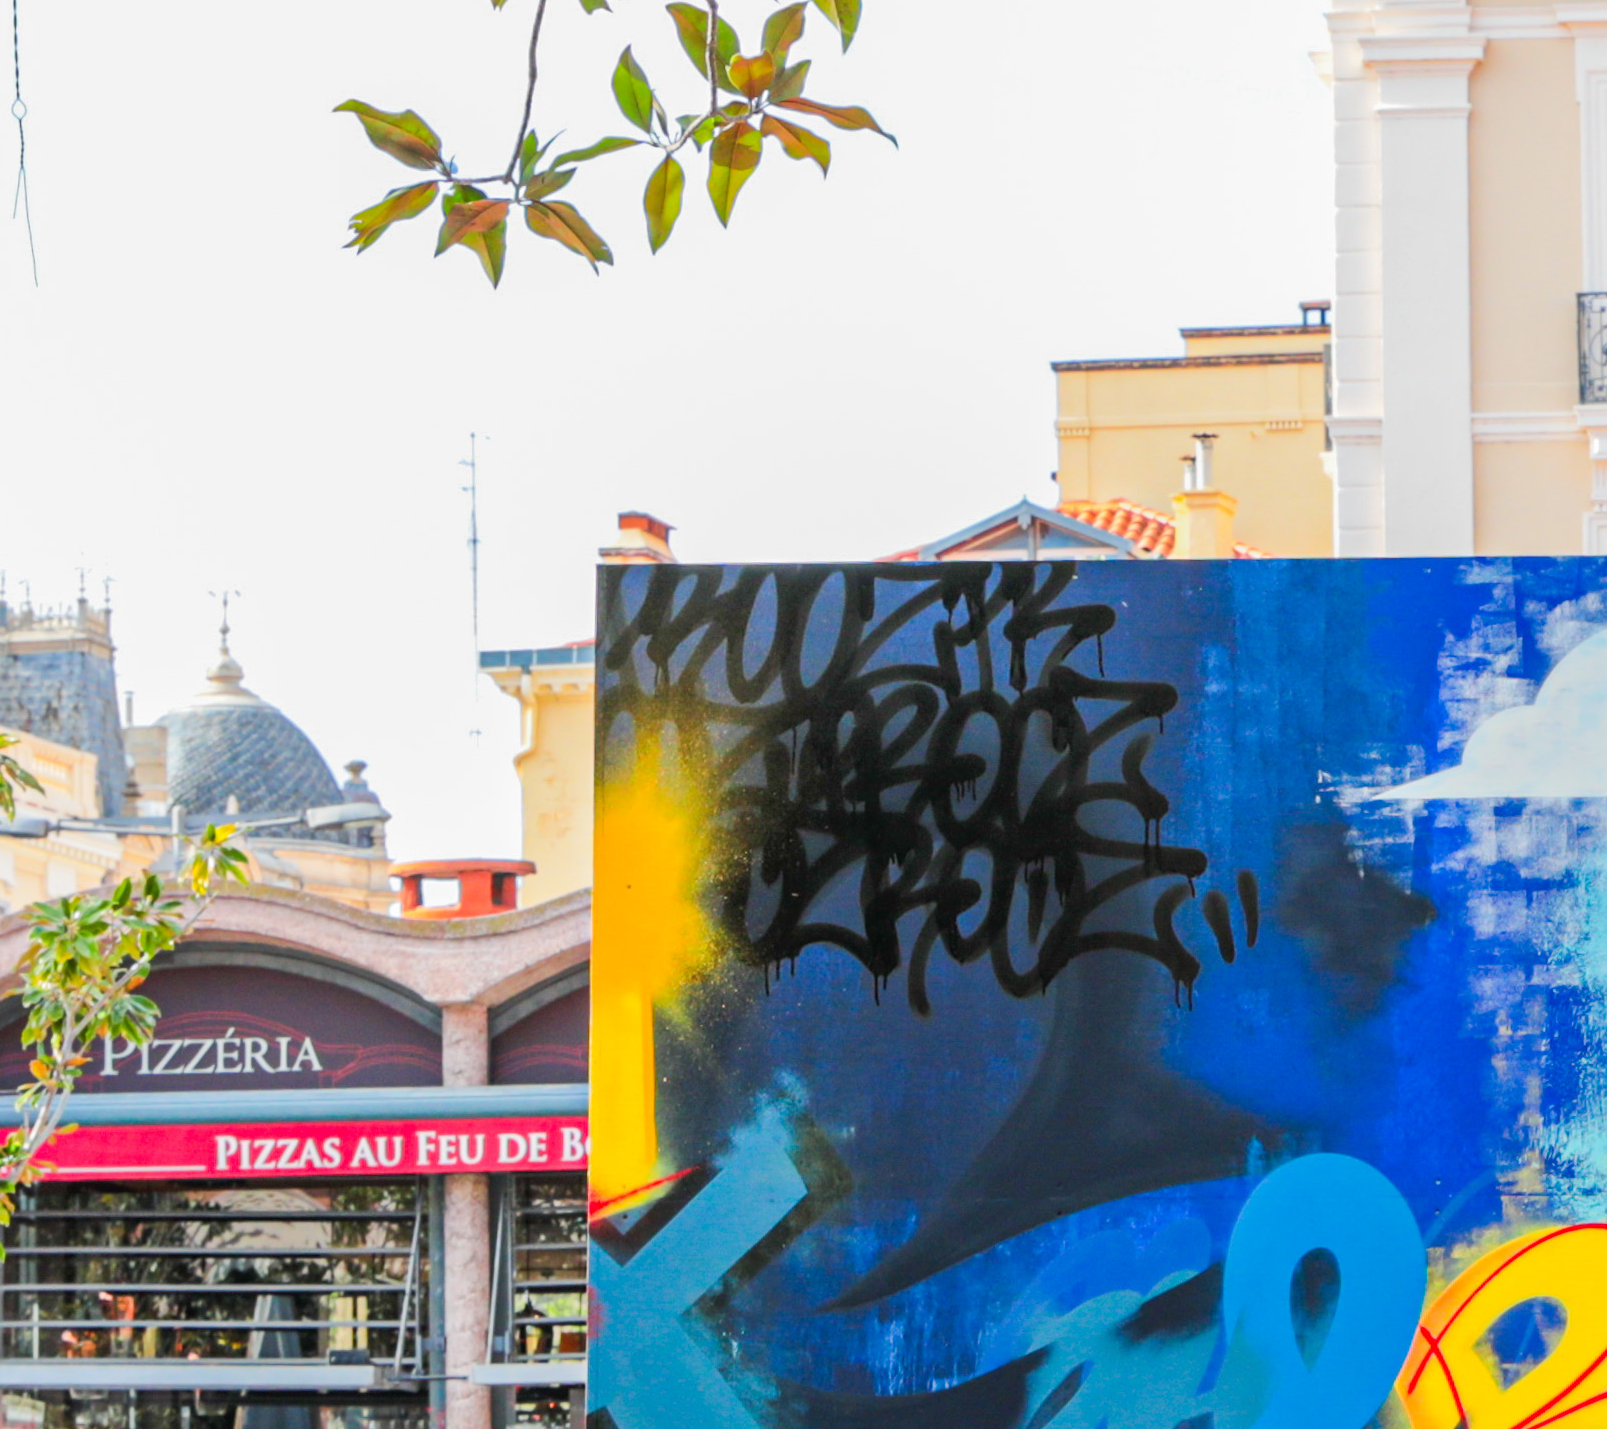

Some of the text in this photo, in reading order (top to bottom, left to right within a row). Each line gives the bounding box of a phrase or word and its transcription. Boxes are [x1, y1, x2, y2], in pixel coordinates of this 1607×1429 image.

[100, 1027, 323, 1076] PIZZÉRIA
[215, 1136, 341, 1170] PIZZAS
[350, 1136, 403, 1167] AU
[416, 1130, 485, 1166] FEU
[498, 1132, 547, 1163] DE
